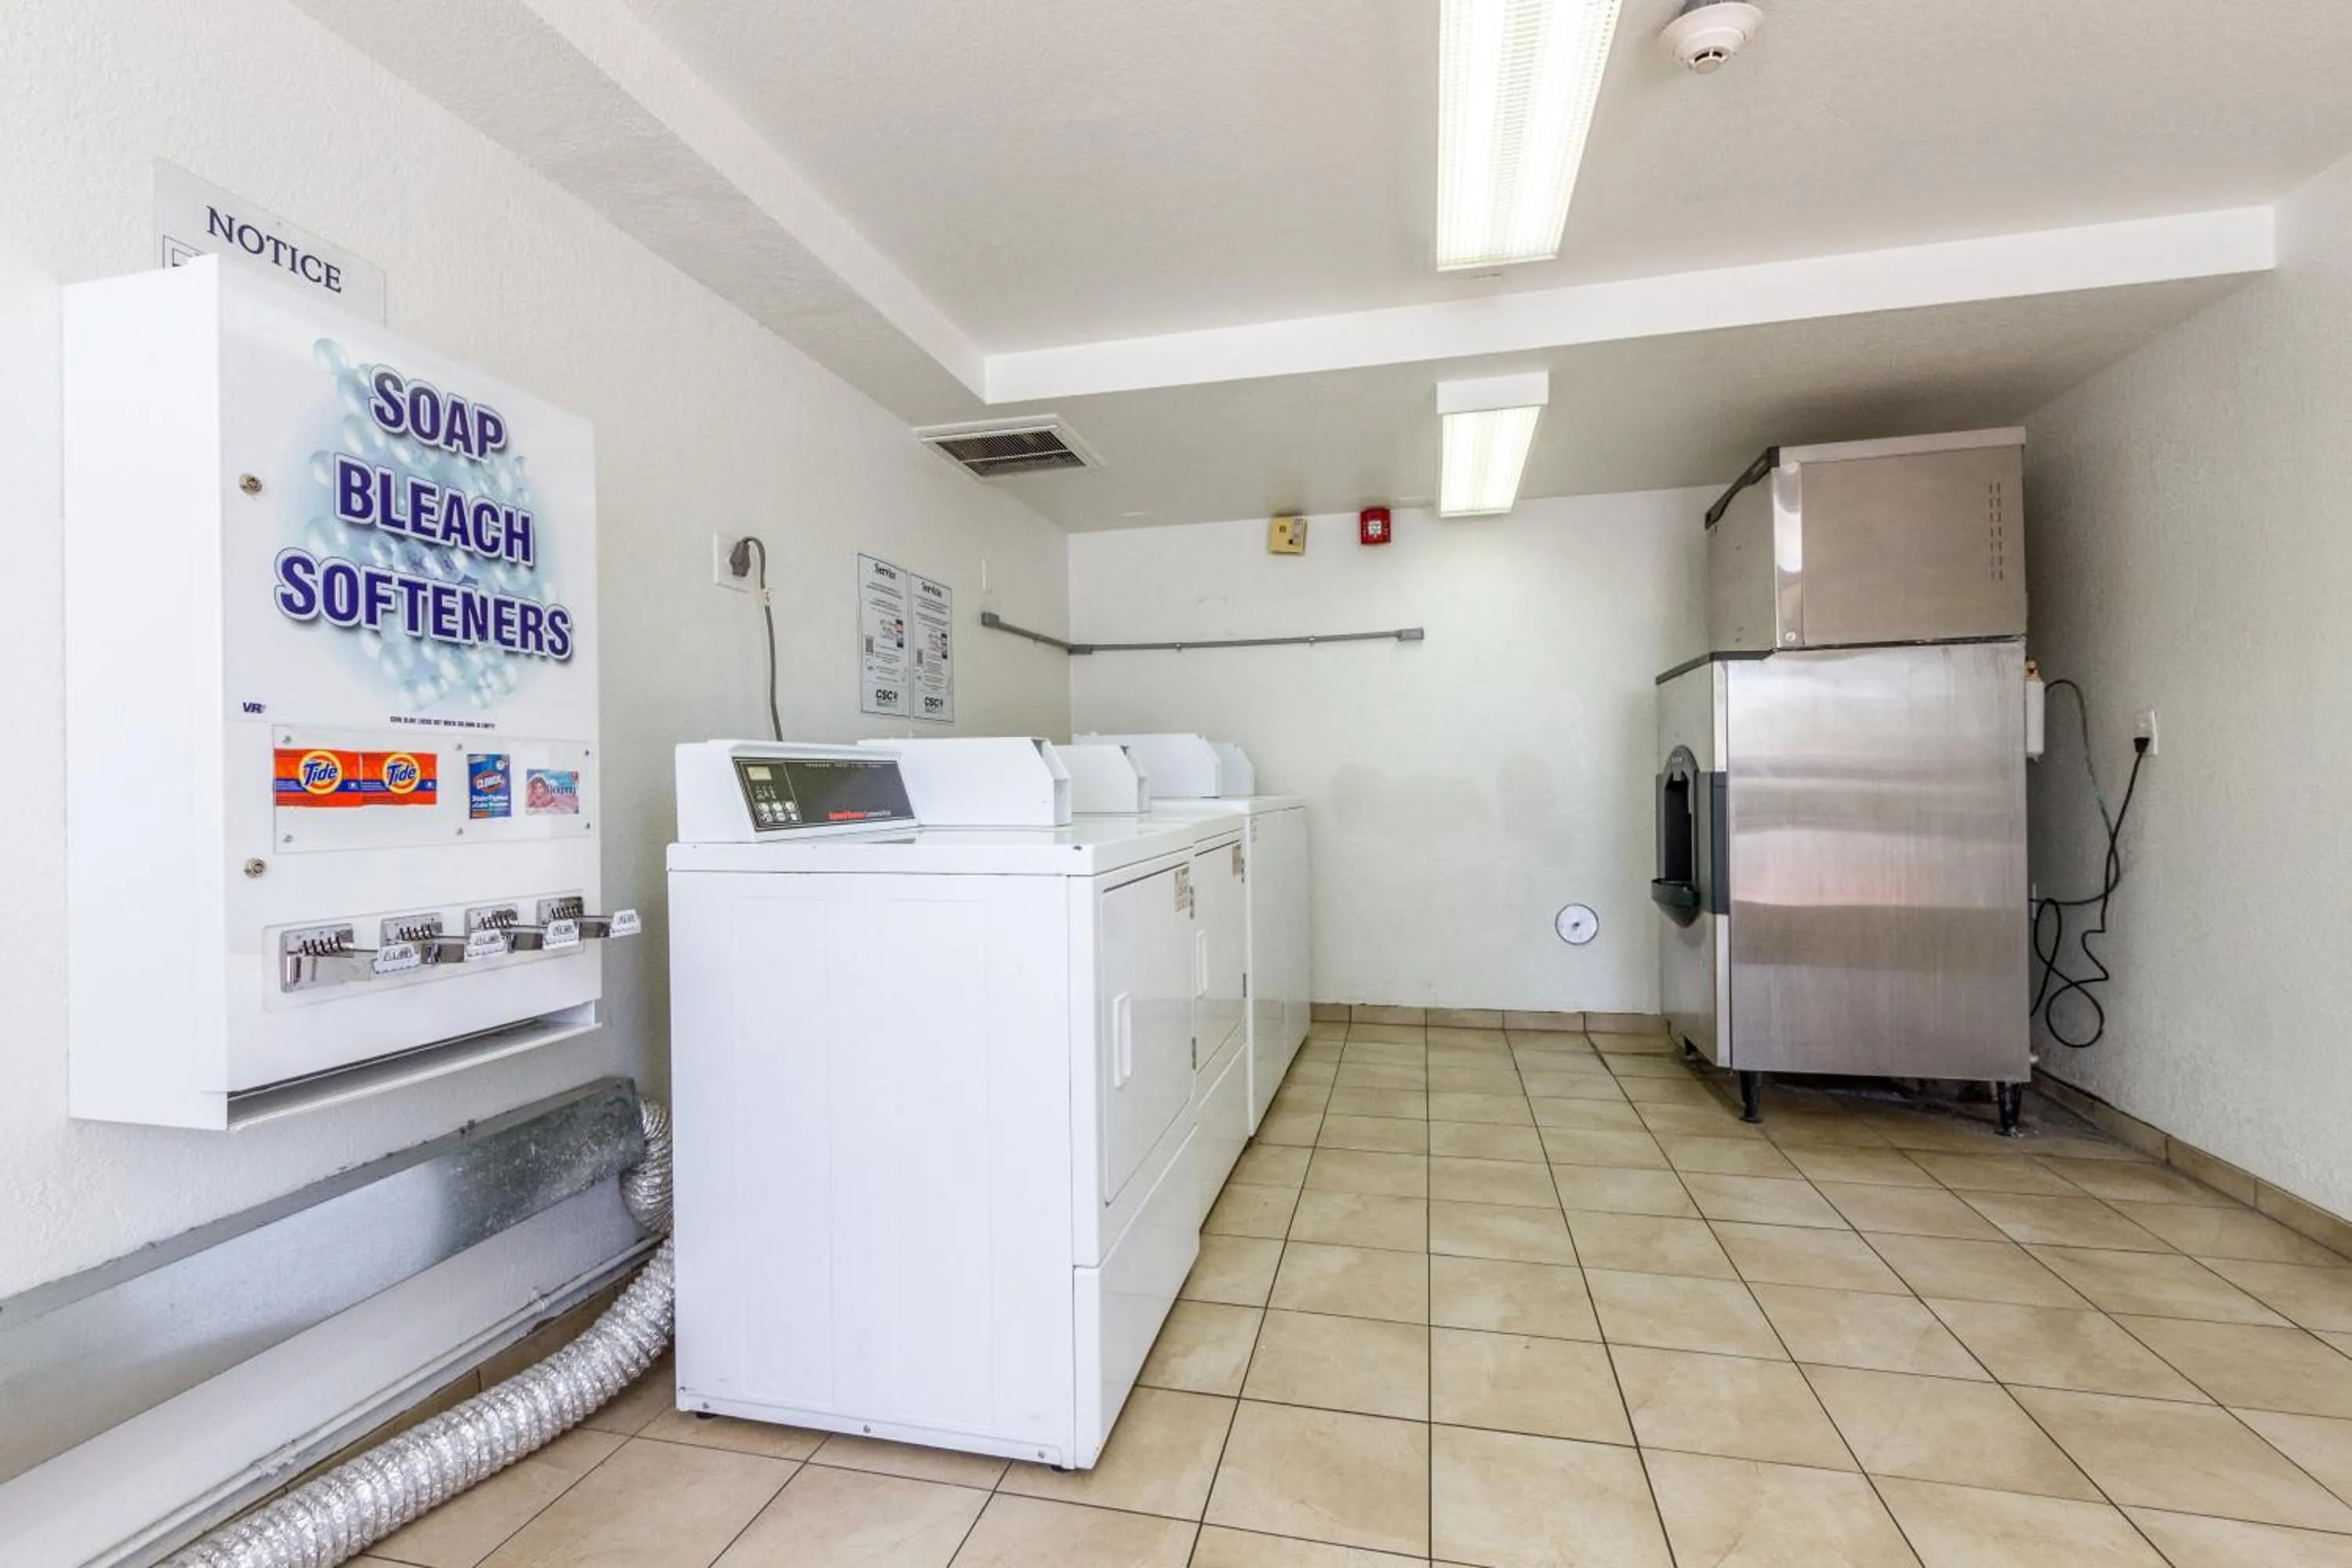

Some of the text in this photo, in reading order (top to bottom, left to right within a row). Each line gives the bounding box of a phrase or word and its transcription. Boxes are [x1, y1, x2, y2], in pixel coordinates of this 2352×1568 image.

[206, 205, 342, 293] NOTICE
[372, 368, 505, 459] SOAP
[337, 458, 534, 564] BLEACH
[278, 552, 572, 658] SOFTENERS
[303, 762, 338, 786] Tide
[387, 763, 416, 786] Tide
